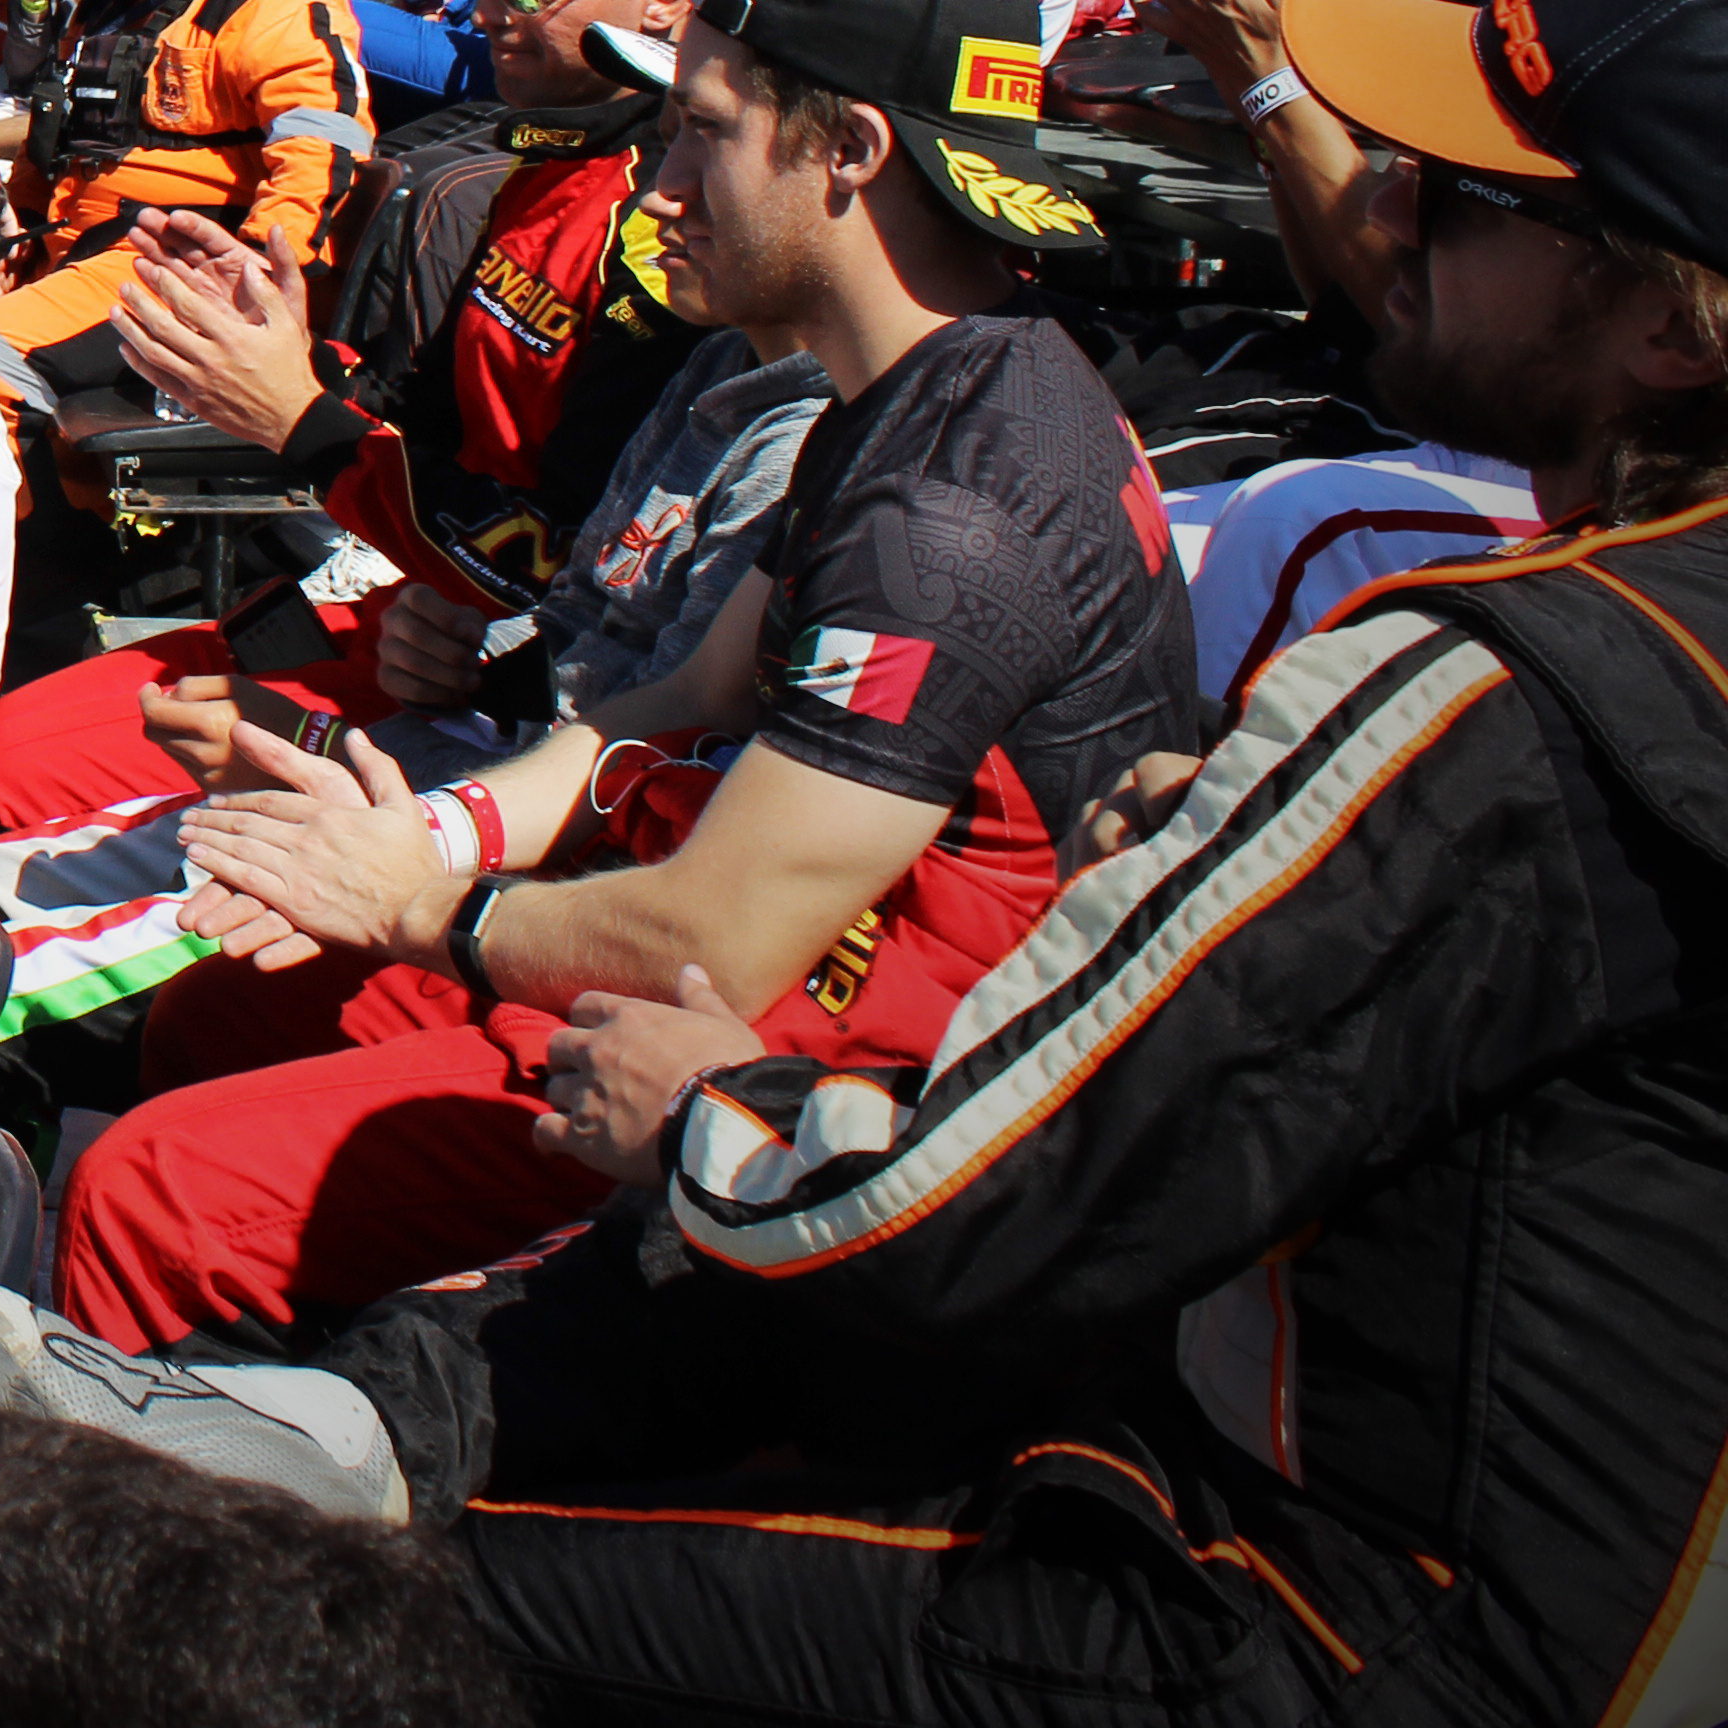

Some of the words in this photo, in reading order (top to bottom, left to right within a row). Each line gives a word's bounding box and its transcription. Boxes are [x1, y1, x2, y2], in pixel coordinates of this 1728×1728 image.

[967, 55, 1043, 107] PIRE
[511, 124, 586, 149] freem
[471, 285, 517, 330] Racing
